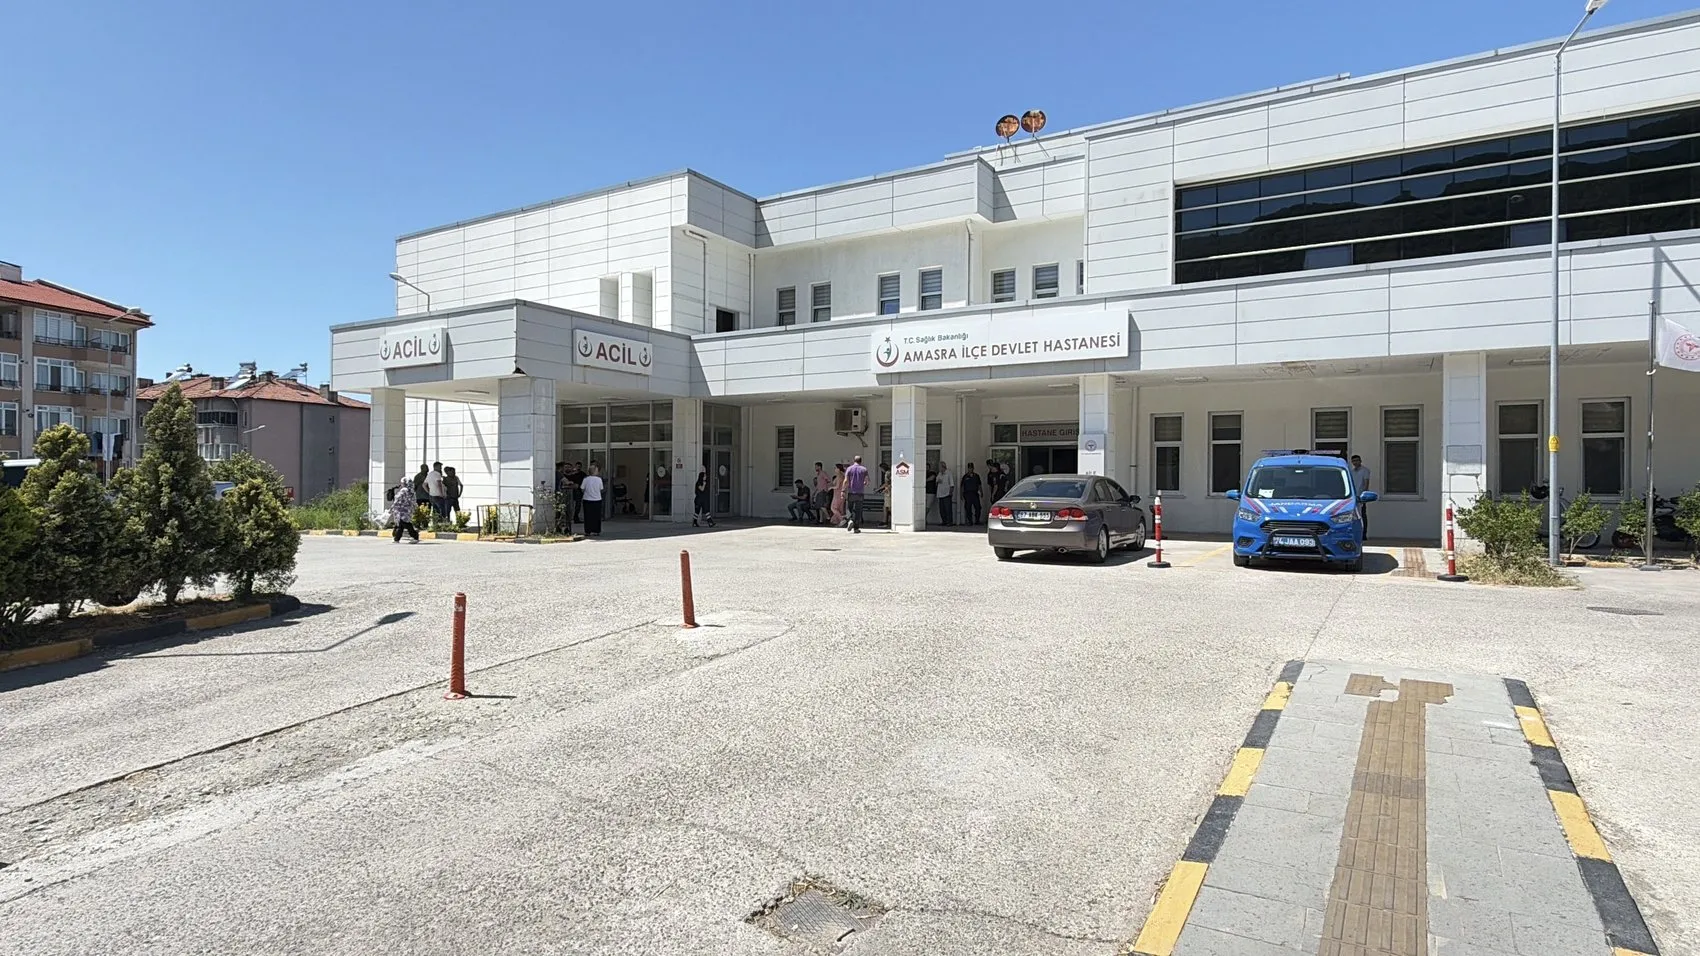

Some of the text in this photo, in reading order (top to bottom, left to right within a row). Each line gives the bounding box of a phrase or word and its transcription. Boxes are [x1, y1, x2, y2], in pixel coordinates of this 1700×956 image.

[393, 336, 427, 359] ACİL
[904, 332, 1121, 362] AMASRA İLÇE DEVLET HASTANESİ
[916, 335, 936, 344] Sağlık
[938, 332, 969, 341] Bakanlığı
[596, 342, 637, 366] ACİL
[1022, 429, 1057, 437] HASTANE
